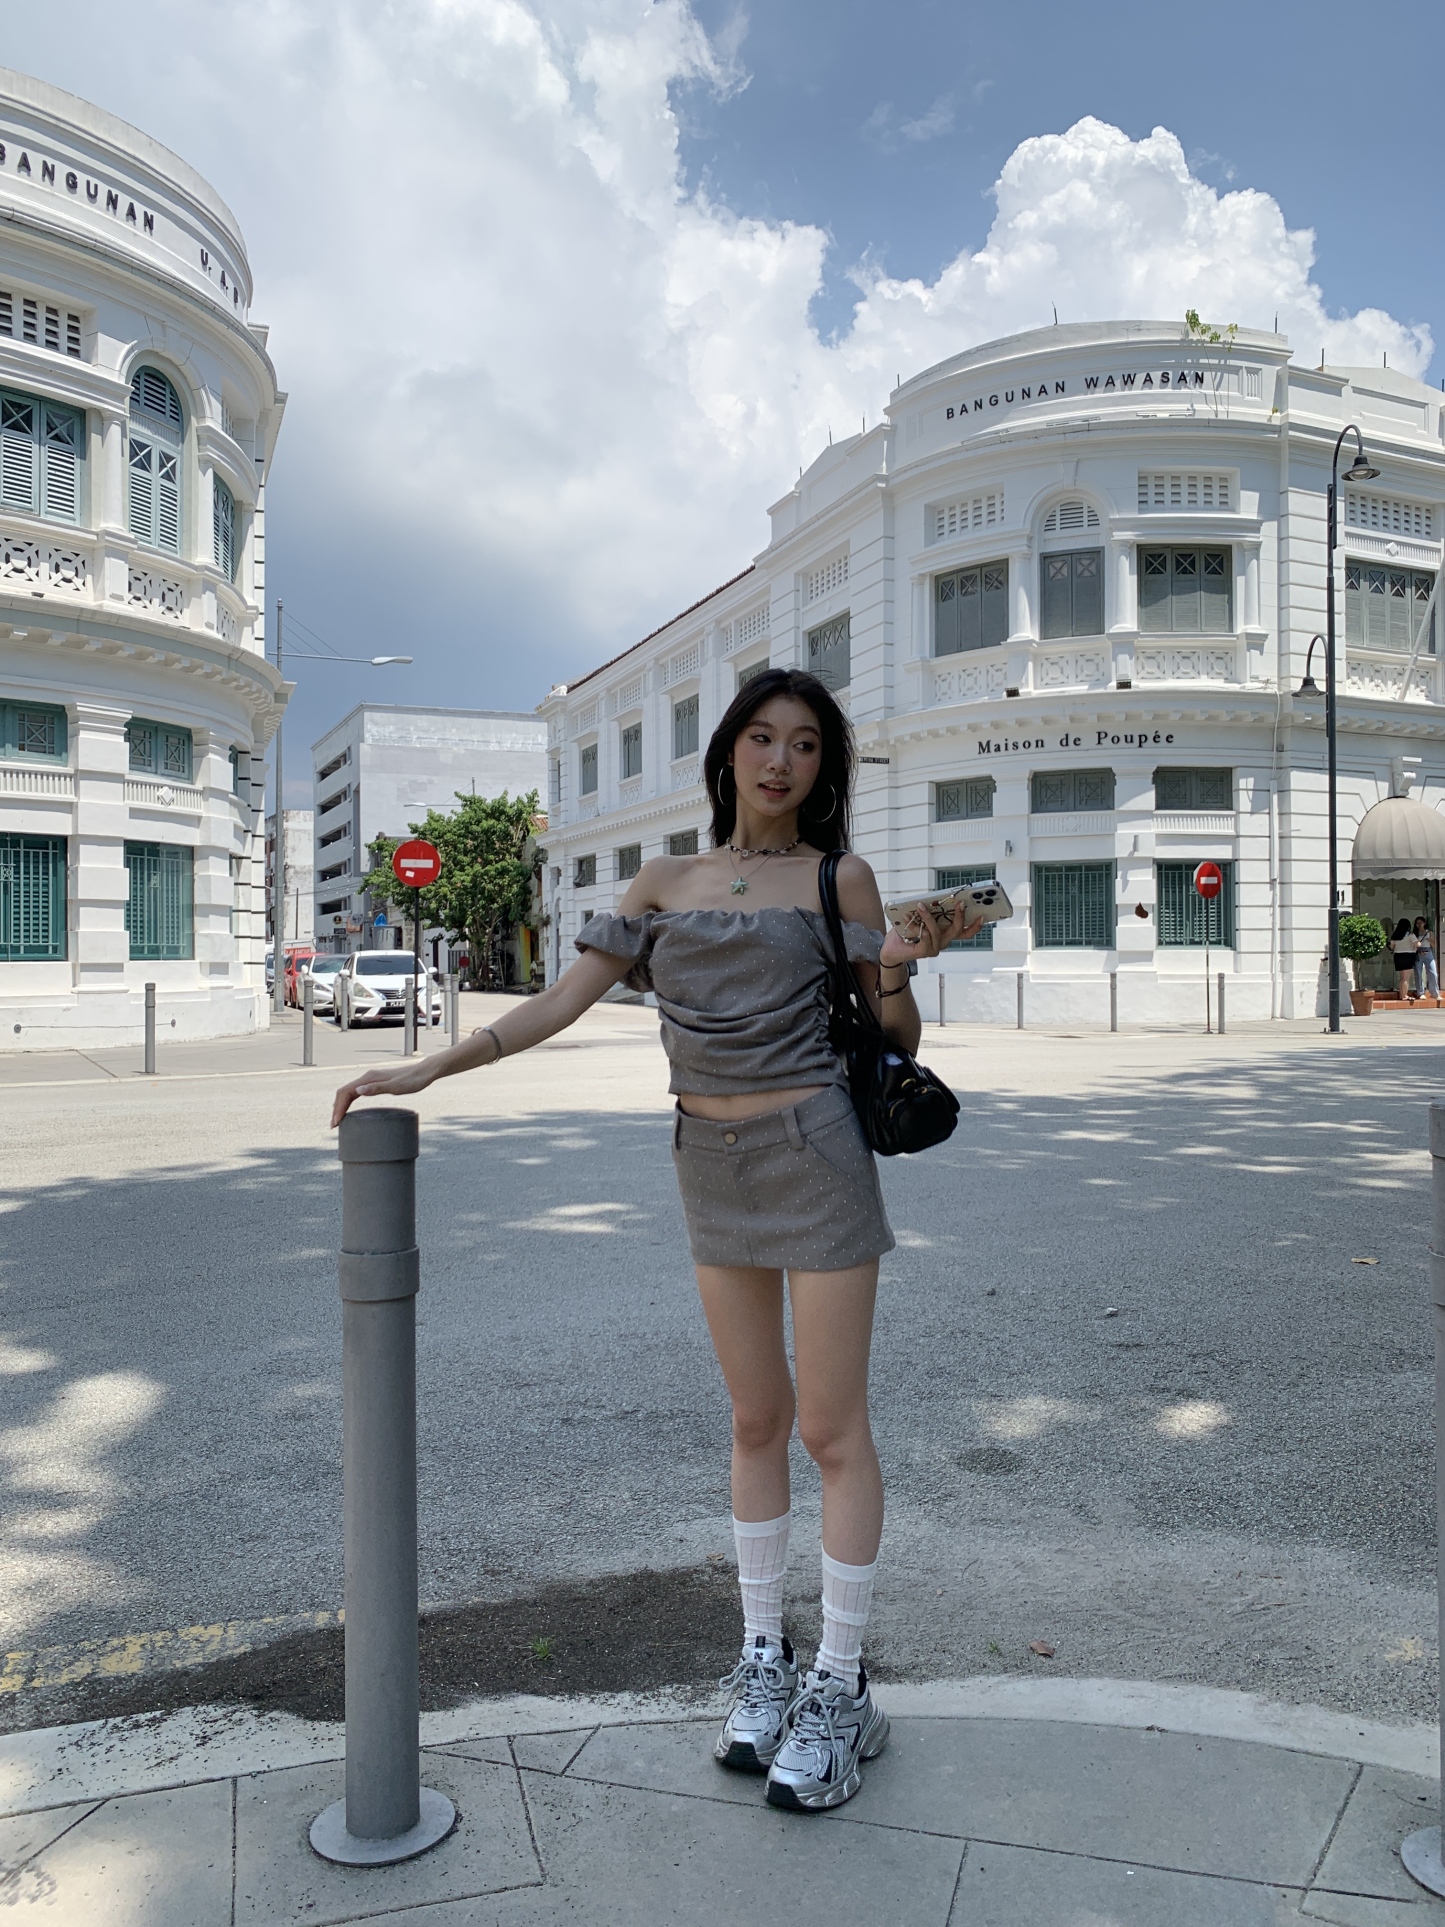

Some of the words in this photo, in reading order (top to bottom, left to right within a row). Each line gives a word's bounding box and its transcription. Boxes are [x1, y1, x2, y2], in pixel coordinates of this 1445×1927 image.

[946, 380, 1066, 420] BANGUNAN
[1084, 371, 1205, 389] WAWASAN
[977, 738, 1045, 754] Maison
[1059, 733, 1082, 747] de
[1096, 731, 1175, 748] Poupée
